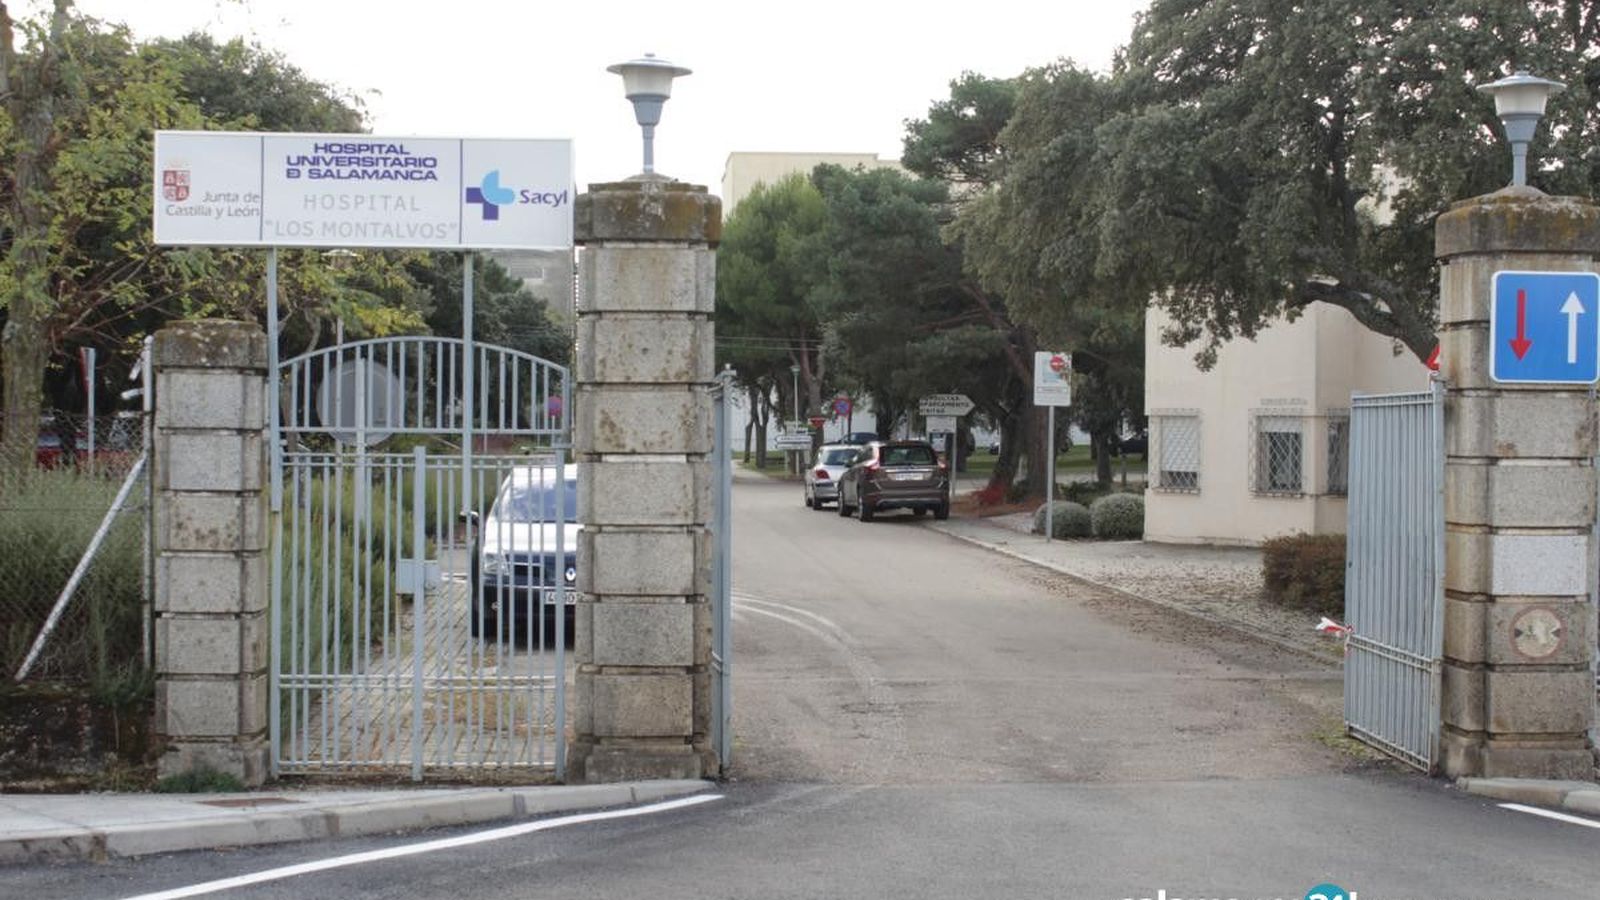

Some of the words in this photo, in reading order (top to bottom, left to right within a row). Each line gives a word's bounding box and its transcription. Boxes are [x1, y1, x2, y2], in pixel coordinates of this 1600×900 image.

[313, 142, 411, 156] HOSPITAL
[286, 155, 438, 169] UNIVERSITARIO
[308, 168, 438, 182] SALAMANCA
[202, 192, 239, 203] Junta
[243, 193, 261, 204] de
[303, 194, 421, 213] HOSPITAL
[519, 189, 568, 208] Sacyl
[166, 204, 212, 217] Castilla
[214, 207, 223, 220] y
[227, 205, 261, 217] León
